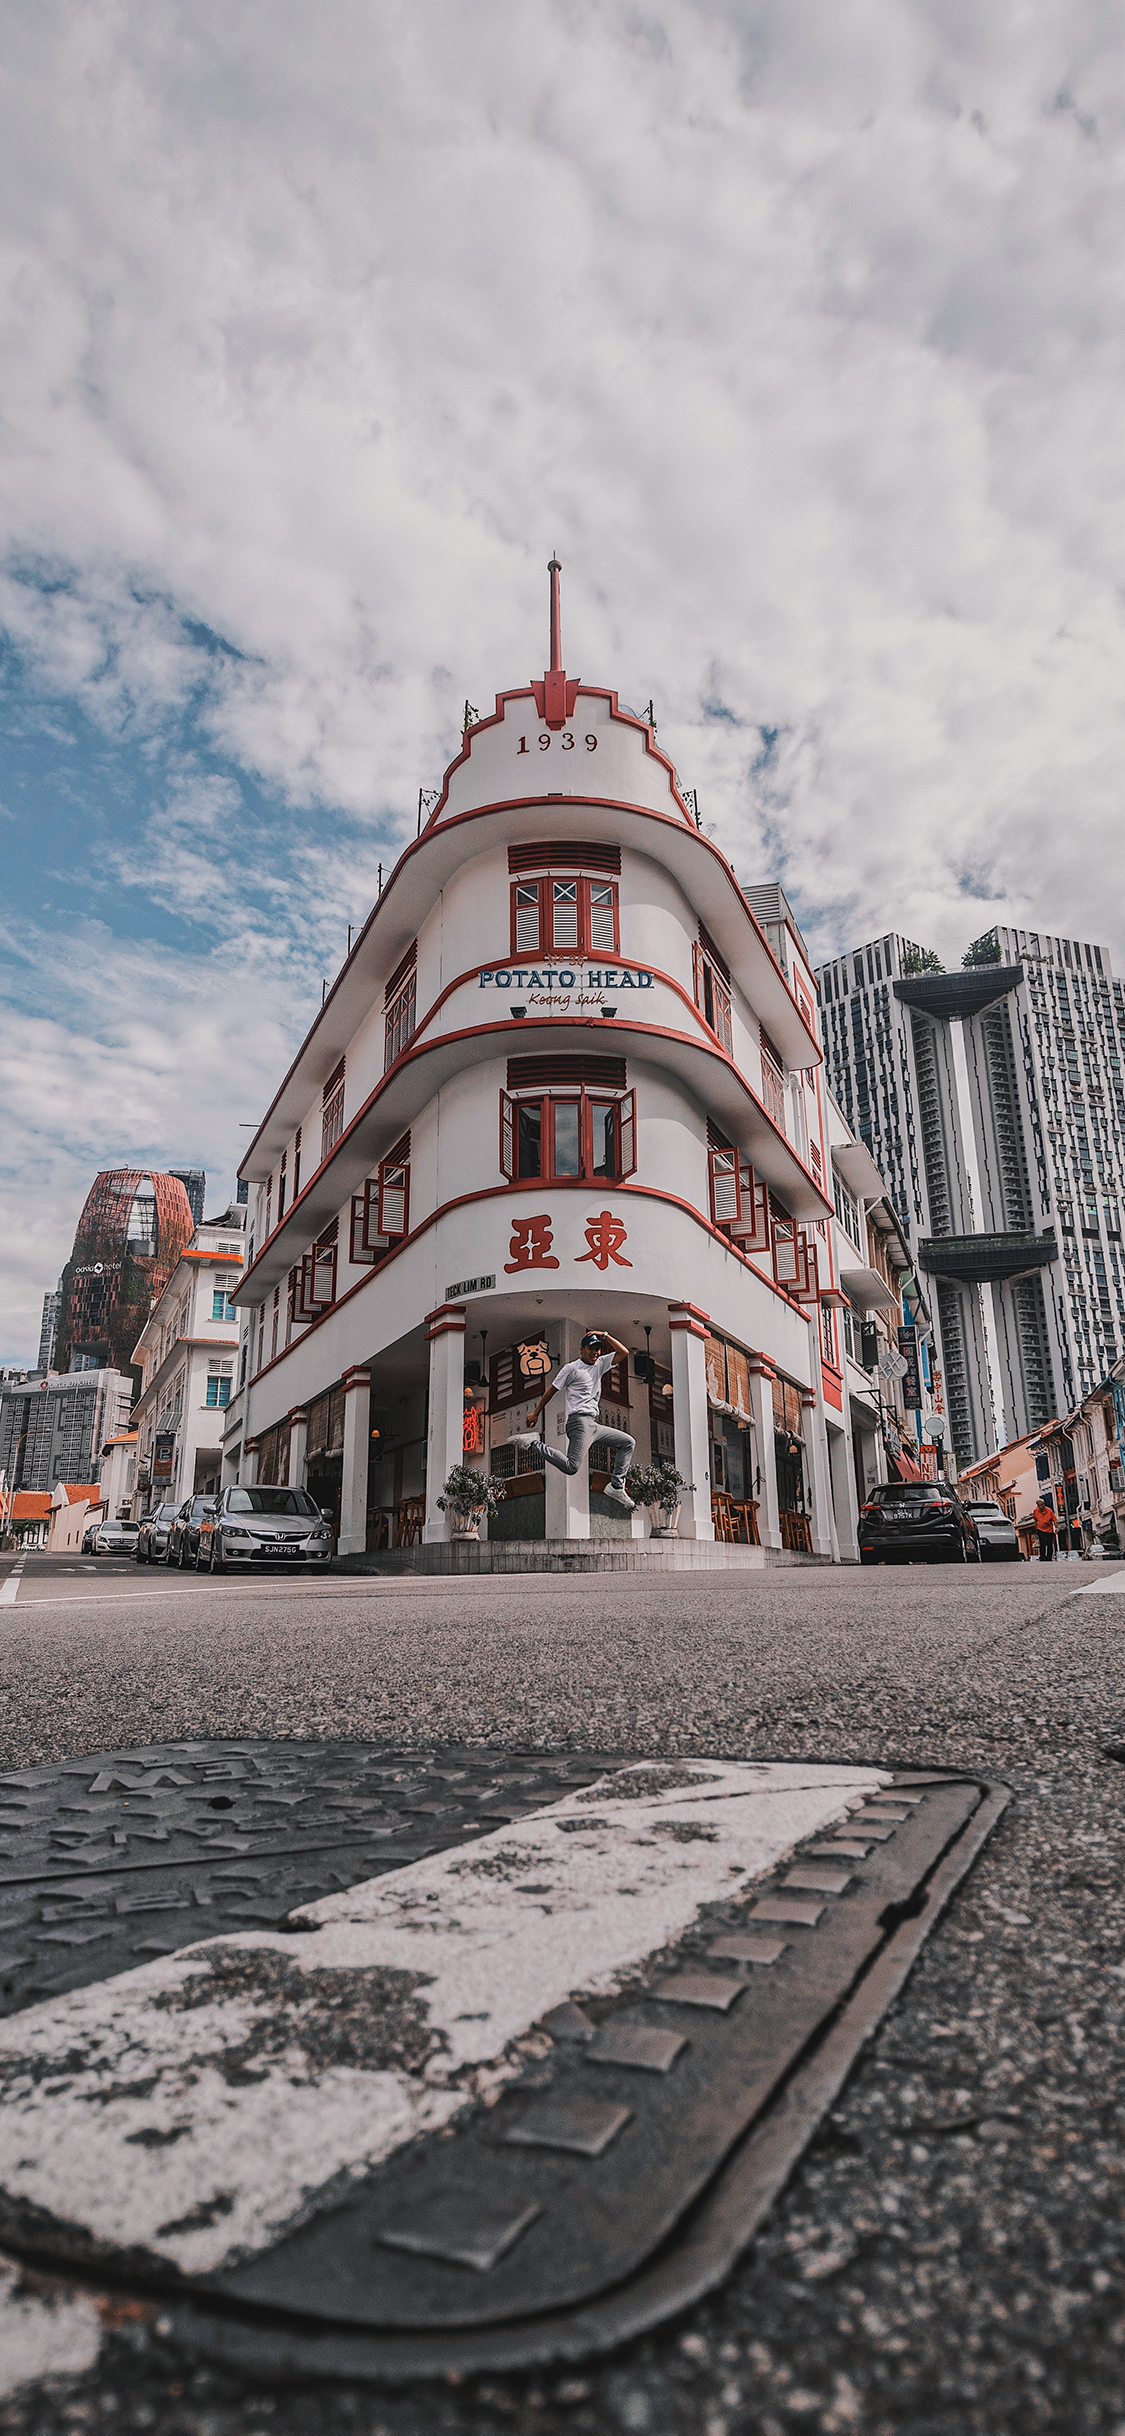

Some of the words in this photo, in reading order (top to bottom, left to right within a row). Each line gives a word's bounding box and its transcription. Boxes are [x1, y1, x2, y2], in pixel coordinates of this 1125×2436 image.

[516, 733, 598, 755] 1939
[479, 970, 576, 988] POTATO
[588, 970, 653, 988] HEAD
[528, 993, 571, 1011] Keong
[447, 1283, 461, 1299] TECK
[463, 1279, 477, 1293] LIM
[480, 1276, 492, 1289] RD
[73, 1378, 97, 1388] HOTEL
[264, 1546, 297, 1554] SJN275G
